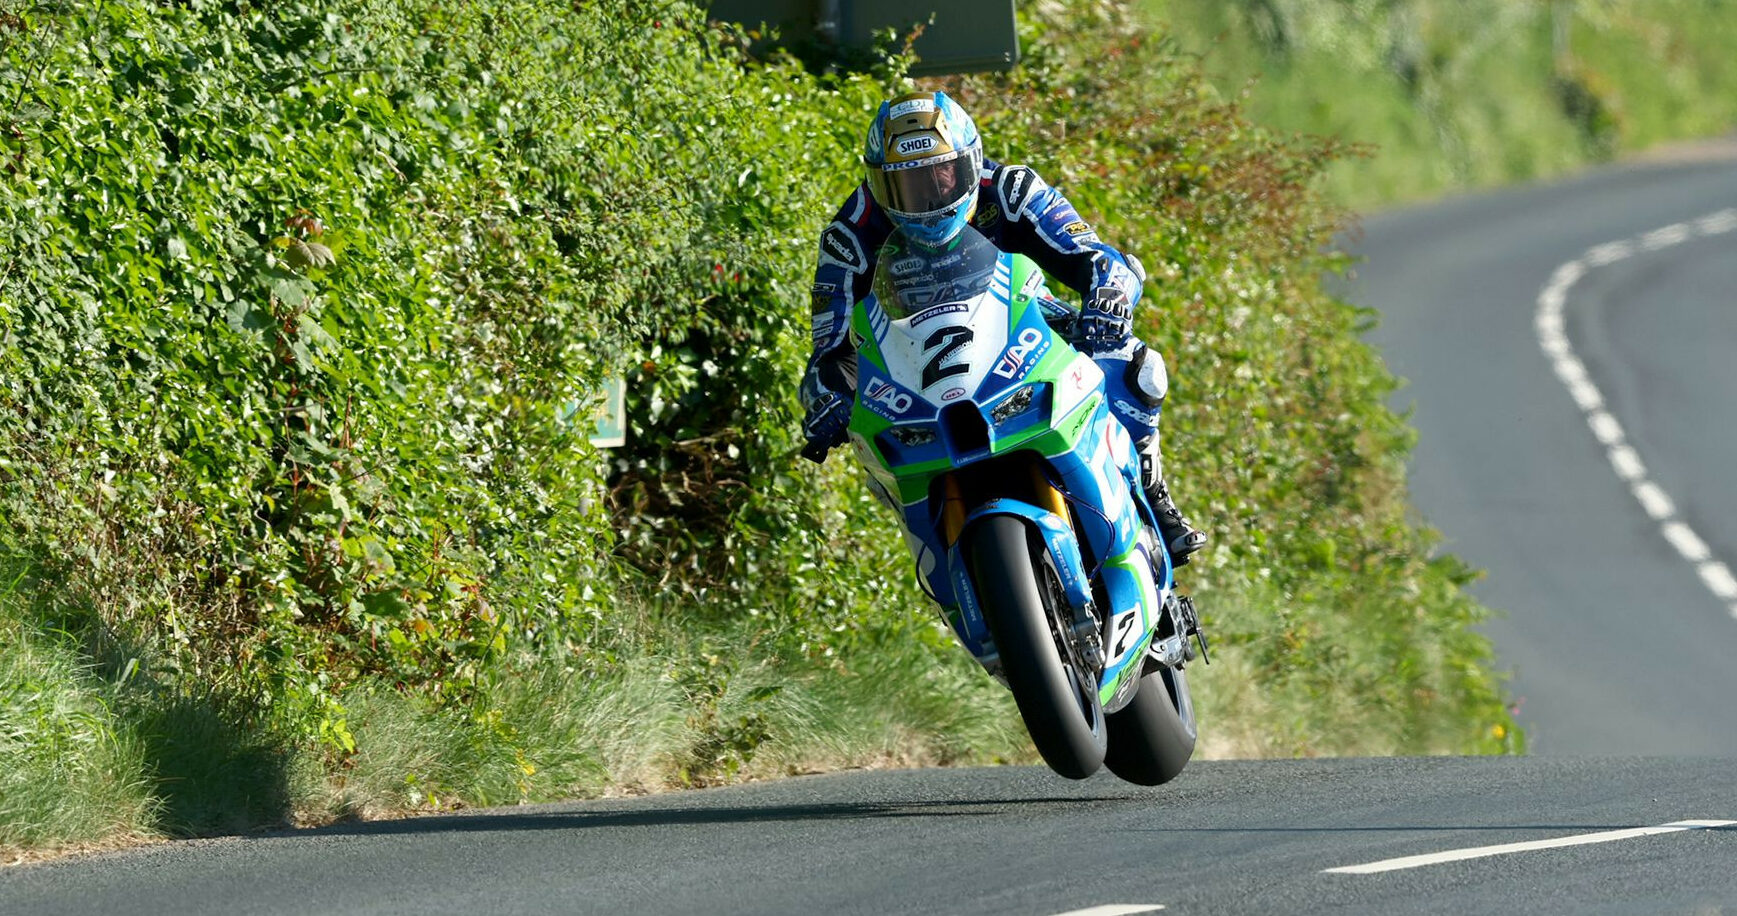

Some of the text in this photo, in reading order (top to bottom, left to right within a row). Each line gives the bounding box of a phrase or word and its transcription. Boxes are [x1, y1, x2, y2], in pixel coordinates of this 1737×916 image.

[901, 138, 932, 152] SHOEI
[1009, 170, 1026, 204] spada
[826, 232, 854, 262] spada
[911, 305, 956, 325] METZELER
[921, 325, 974, 391] 2
[993, 328, 1043, 379] DAO
[1018, 341, 1050, 379] RACING
[862, 400, 896, 420] RACING
[864, 376, 913, 414] DAO
[1052, 537, 1071, 580] METZELER
[1114, 611, 1136, 658] 2
